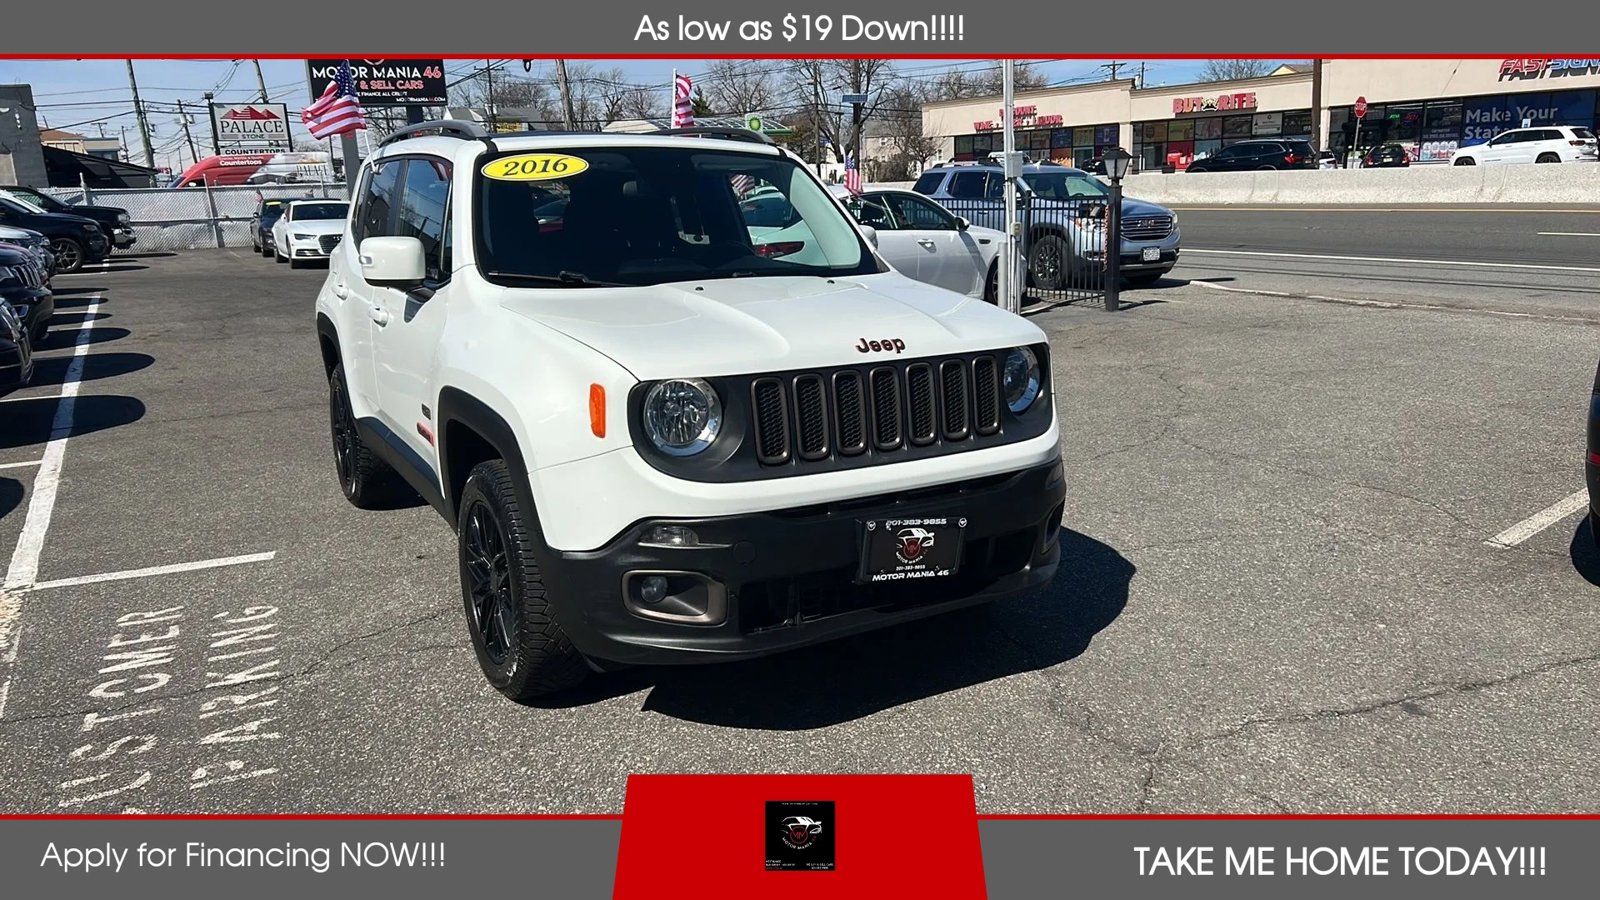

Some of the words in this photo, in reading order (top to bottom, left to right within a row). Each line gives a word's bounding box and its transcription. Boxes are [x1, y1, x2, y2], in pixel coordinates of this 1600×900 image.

[312, 67, 368, 79] MOOR
[372, 66, 421, 78] MANIA
[423, 65, 442, 79] 46
[1499, 59, 1600, 74] FASTSIGN
[360, 81, 369, 90] &
[370, 80, 395, 90] SELL
[396, 80, 424, 90] CARS
[1173, 96, 1203, 113] BUY
[1217, 92, 1257, 111] RITE
[1466, 107, 1512, 123] Make
[1516, 106, 1558, 120] Your
[220, 121, 284, 133] PALACE
[503, 157, 569, 177] 2016
[855, 337, 906, 354] Jeep
[872, 572, 906, 582] MOTOR
[906, 570, 936, 579] MANIA
